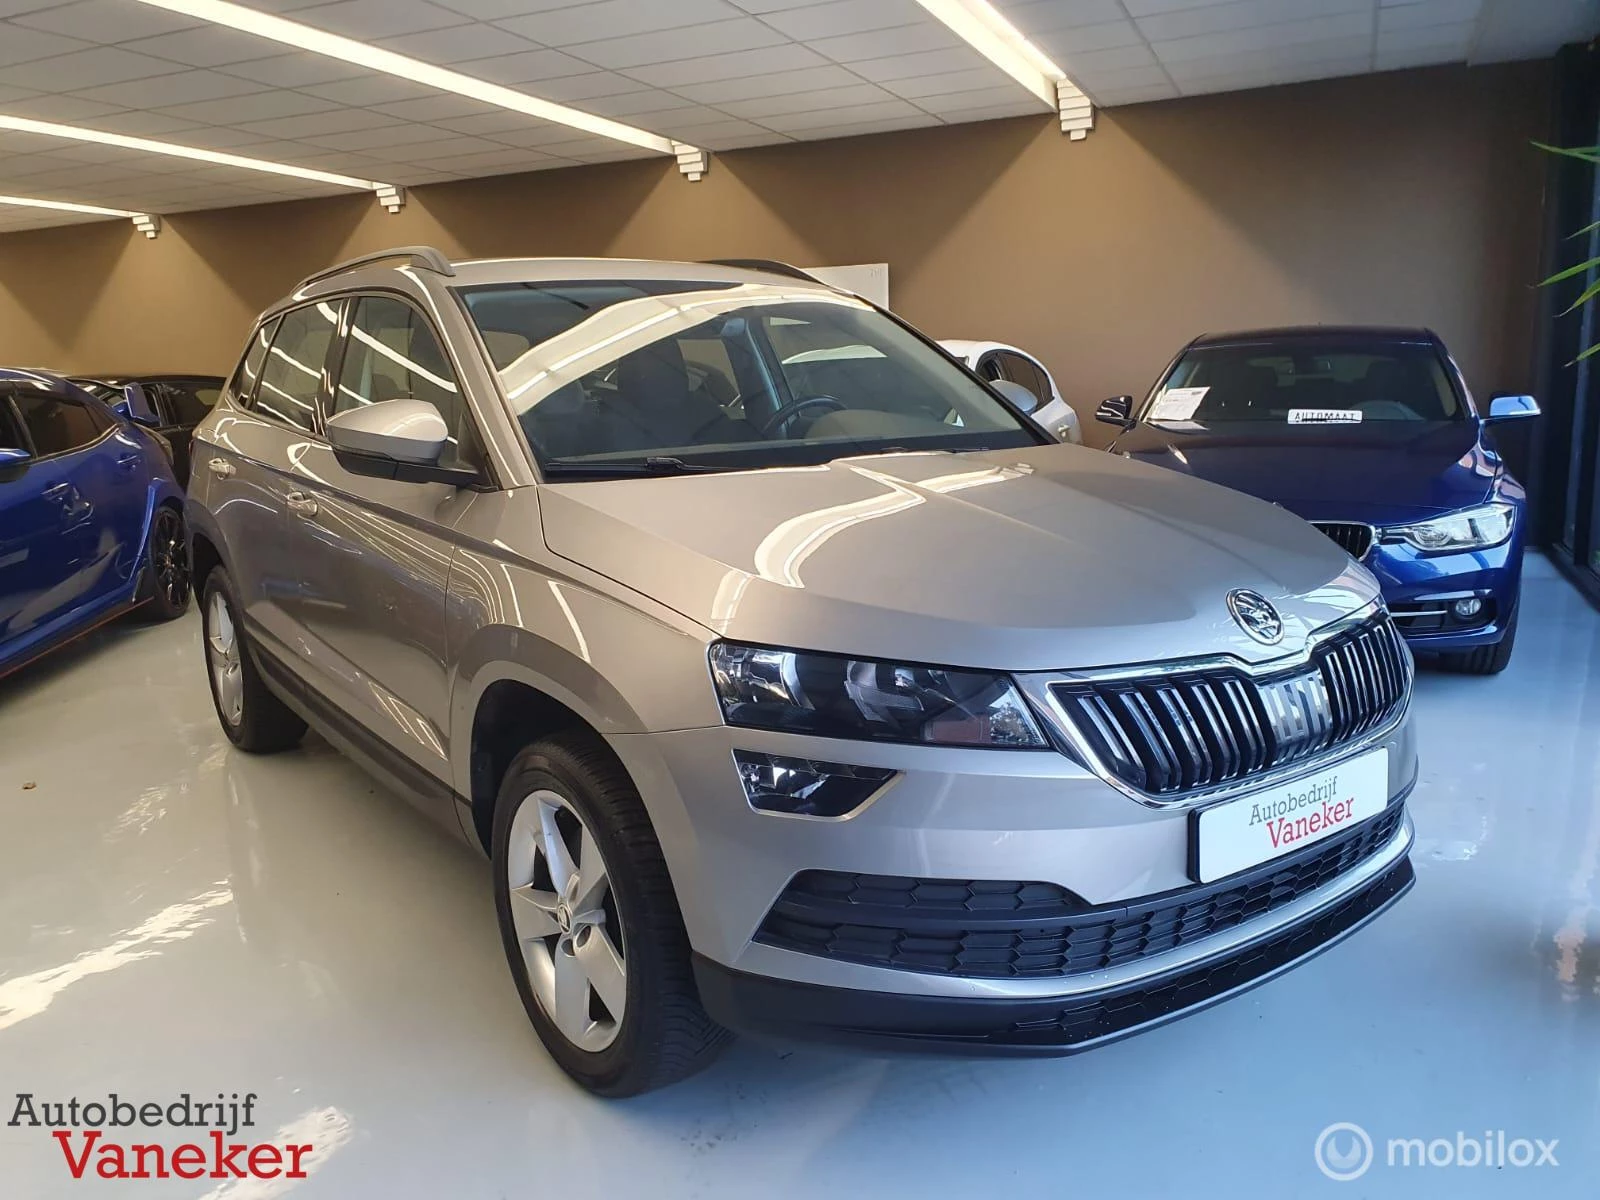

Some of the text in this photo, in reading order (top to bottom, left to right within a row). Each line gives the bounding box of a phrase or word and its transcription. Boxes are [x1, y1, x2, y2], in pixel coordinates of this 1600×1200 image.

[1294, 411, 1355, 421] AUTOMAAT
[1249, 776, 1338, 826] Autobedrijf
[1266, 797, 1354, 848] Vaneker
